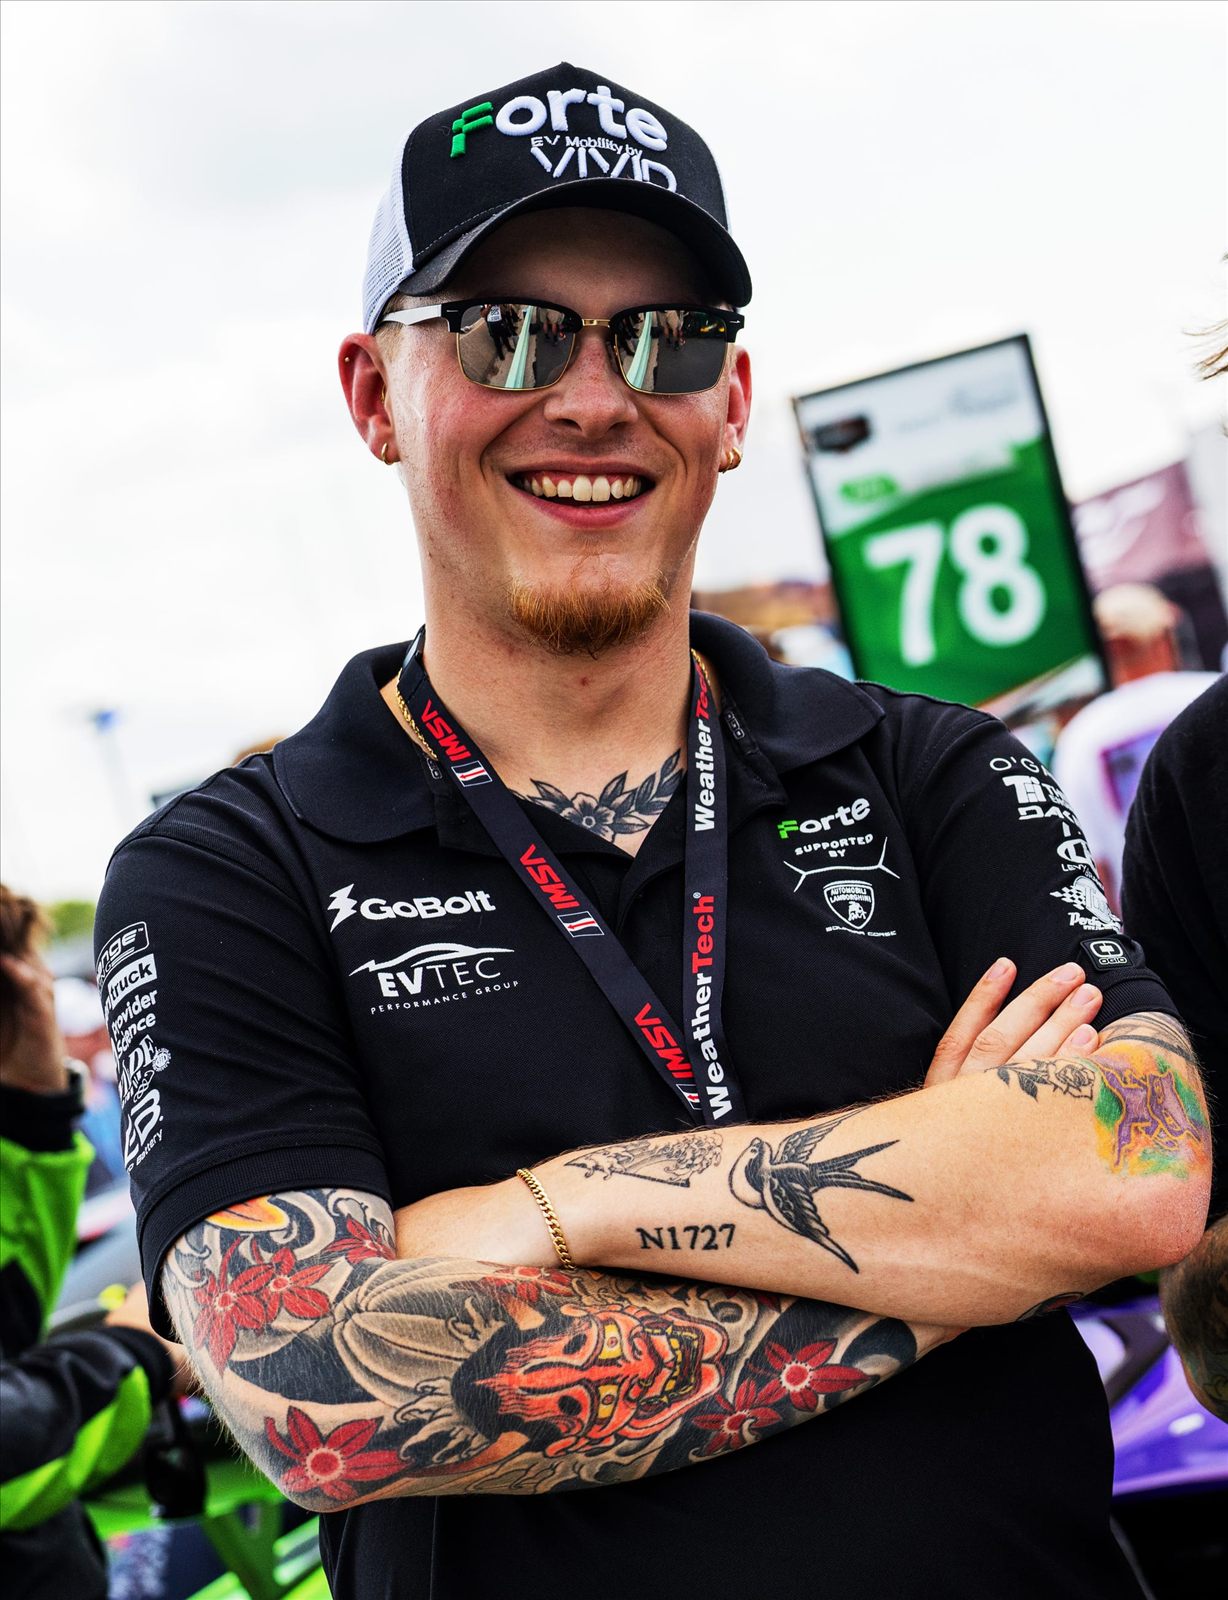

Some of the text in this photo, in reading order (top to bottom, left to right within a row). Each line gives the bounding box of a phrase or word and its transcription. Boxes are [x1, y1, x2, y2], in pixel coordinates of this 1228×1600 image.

[450, 85, 668, 158] Forte
[531, 135, 643, 156] EV Mobility by
[531, 147, 677, 193] VIVID
[862, 502, 1046, 668] 78
[777, 798, 871, 839] Forte
[794, 833, 874, 856] SUPPORTED
[828, 849, 846, 858] BY
[360, 890, 496, 921] GoBolt
[377, 957, 501, 998] EVTEC
[370, 981, 519, 1015] PERFORMANCE GROUP
[635, 1223, 736, 1250] N1727
